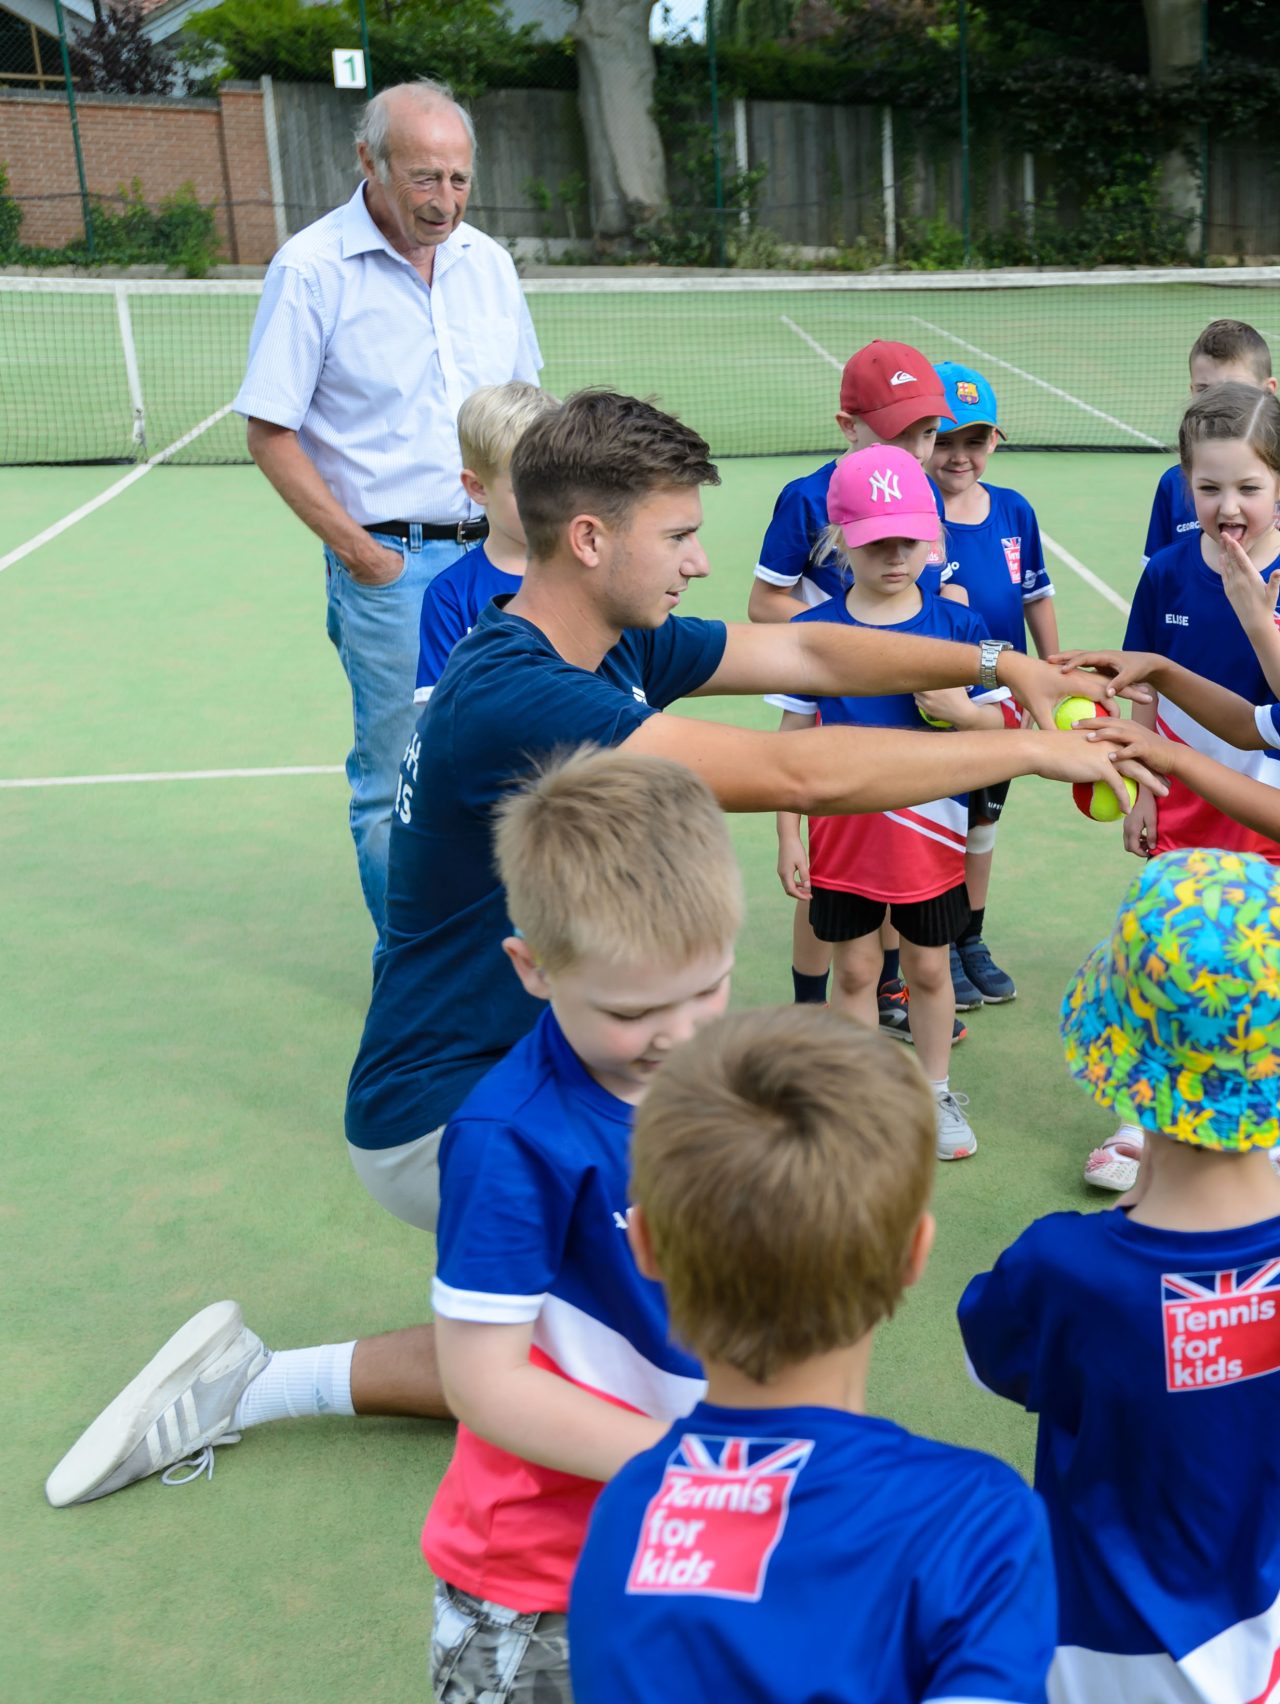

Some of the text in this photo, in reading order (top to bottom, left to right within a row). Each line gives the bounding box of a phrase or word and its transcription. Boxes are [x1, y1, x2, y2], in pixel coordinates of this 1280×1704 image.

[343, 54, 356, 82] 1
[868, 468, 903, 503] NY
[1165, 613, 1190, 627] ELISE
[1168, 1295, 1277, 1333] Tennis
[1171, 1334, 1223, 1361] for
[1173, 1356, 1243, 1387] kids
[661, 1475, 773, 1515] Tennis
[648, 1507, 705, 1548] for
[635, 1549, 716, 1587] kids
